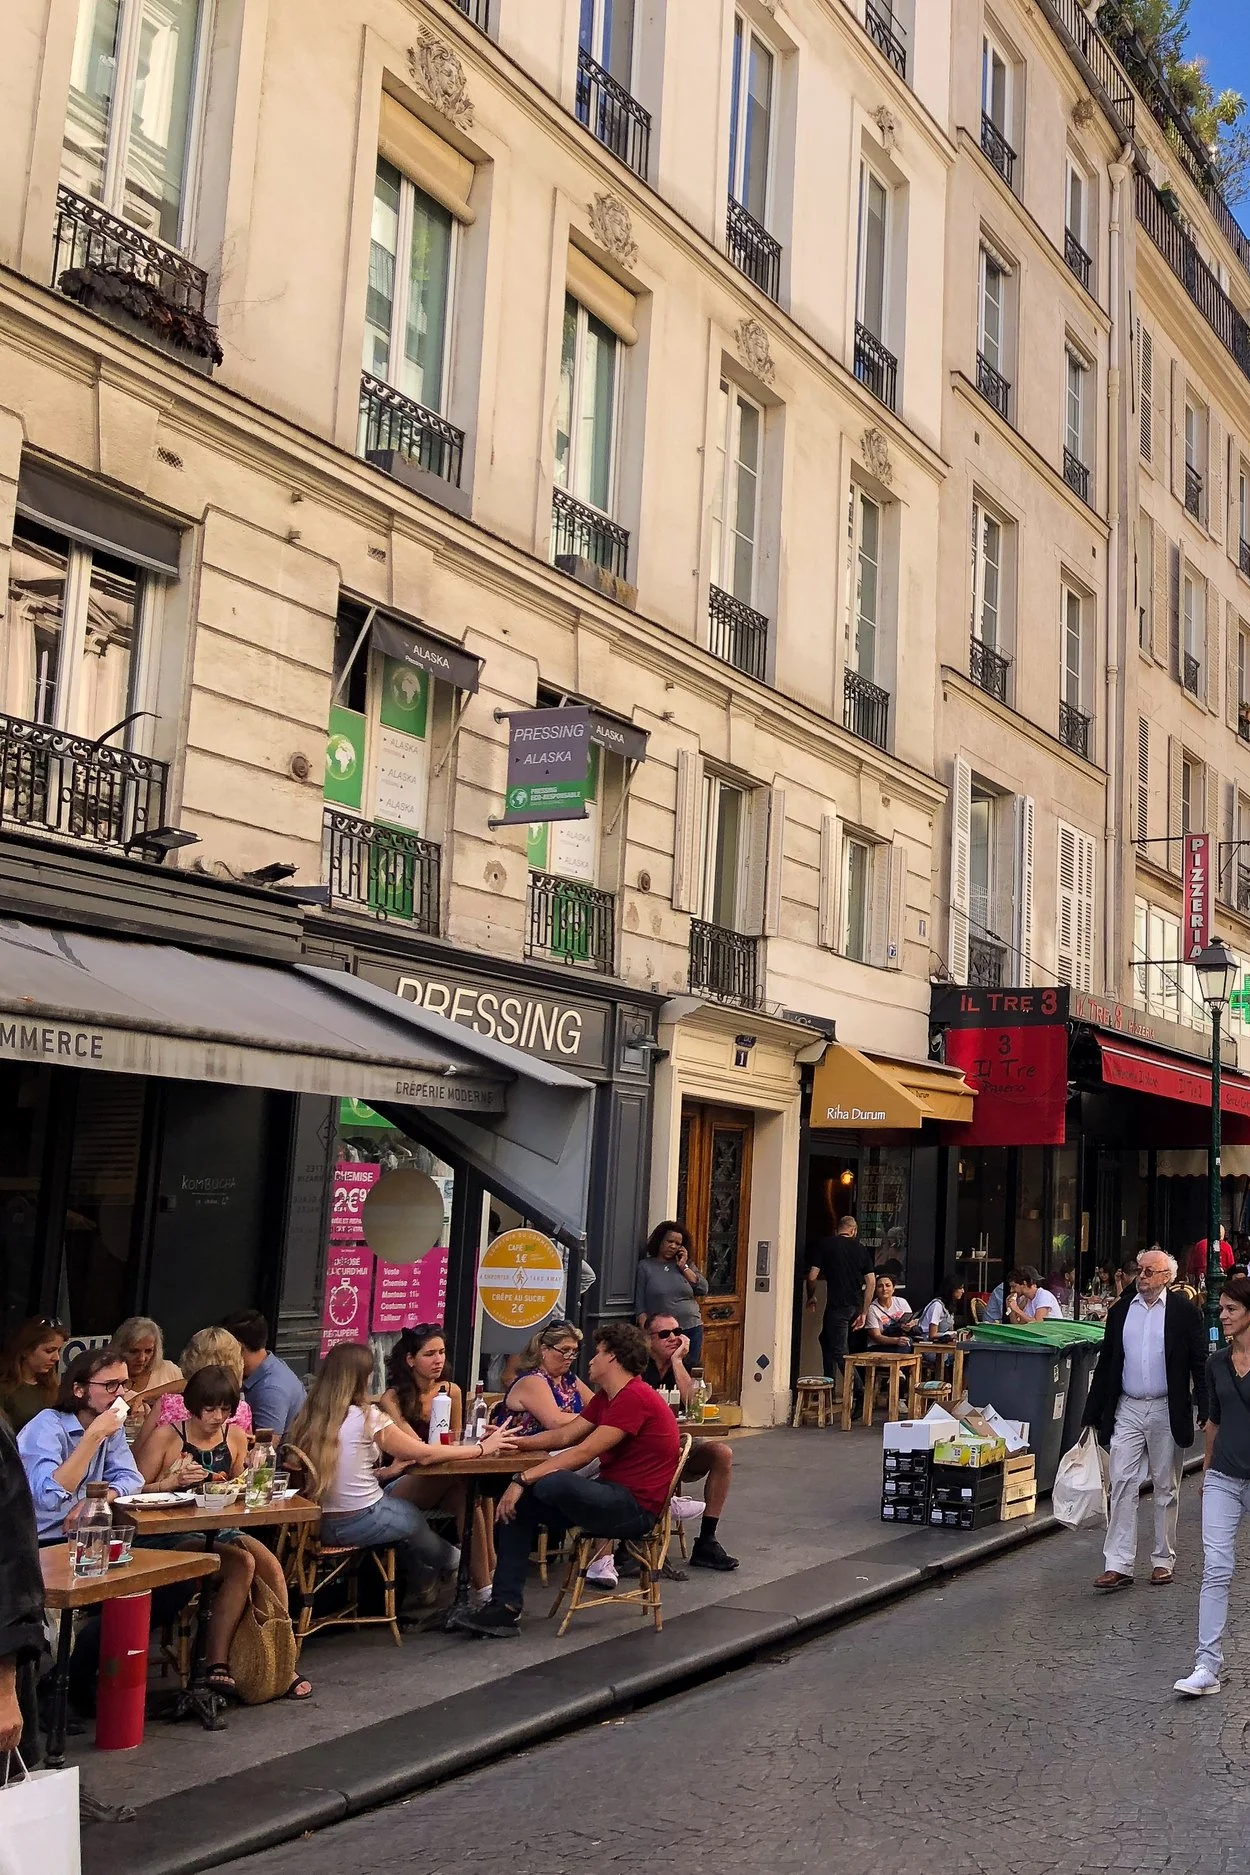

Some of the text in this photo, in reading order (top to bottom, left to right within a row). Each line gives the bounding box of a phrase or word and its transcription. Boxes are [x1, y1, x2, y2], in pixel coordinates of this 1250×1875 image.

[413, 645, 450, 669] ALASKA
[514, 724, 584, 742] PRESSING
[596, 726, 625, 744] ALASKA
[390, 738, 418, 754] ALASKA
[524, 750, 572, 765] ALASKA
[388, 768, 417, 785] ALASKA
[385, 798, 414, 814] ALASKA
[1190, 838, 1204, 958] PIZZERIA
[960, 989, 1058, 1015] IL TRE 3
[396, 976, 582, 1054] PRESSING
[1088, 1000, 1112, 1026] TRE
[1114, 1006, 1123, 1030] 3
[1128, 1019, 1155, 1039] PIZZERIA
[0, 1022, 104, 1058] MMERCE
[998, 1034, 1012, 1055] 3
[740, 1052, 744, 1066] 1
[1002, 1058, 1038, 1078] Tre
[448, 1089, 493, 1104] MODERNE
[826, 1104, 886, 1120] Riha Durum
[334, 1170, 374, 1182] CHEMISE
[508, 1244, 523, 1252] CAFÉ
[515, 1254, 528, 1262] 1€
[384, 1268, 400, 1276] Veste
[492, 1292, 512, 1300] CRÊPE
[380, 1302, 406, 1310] Costume
[512, 1304, 524, 1313] 2€
